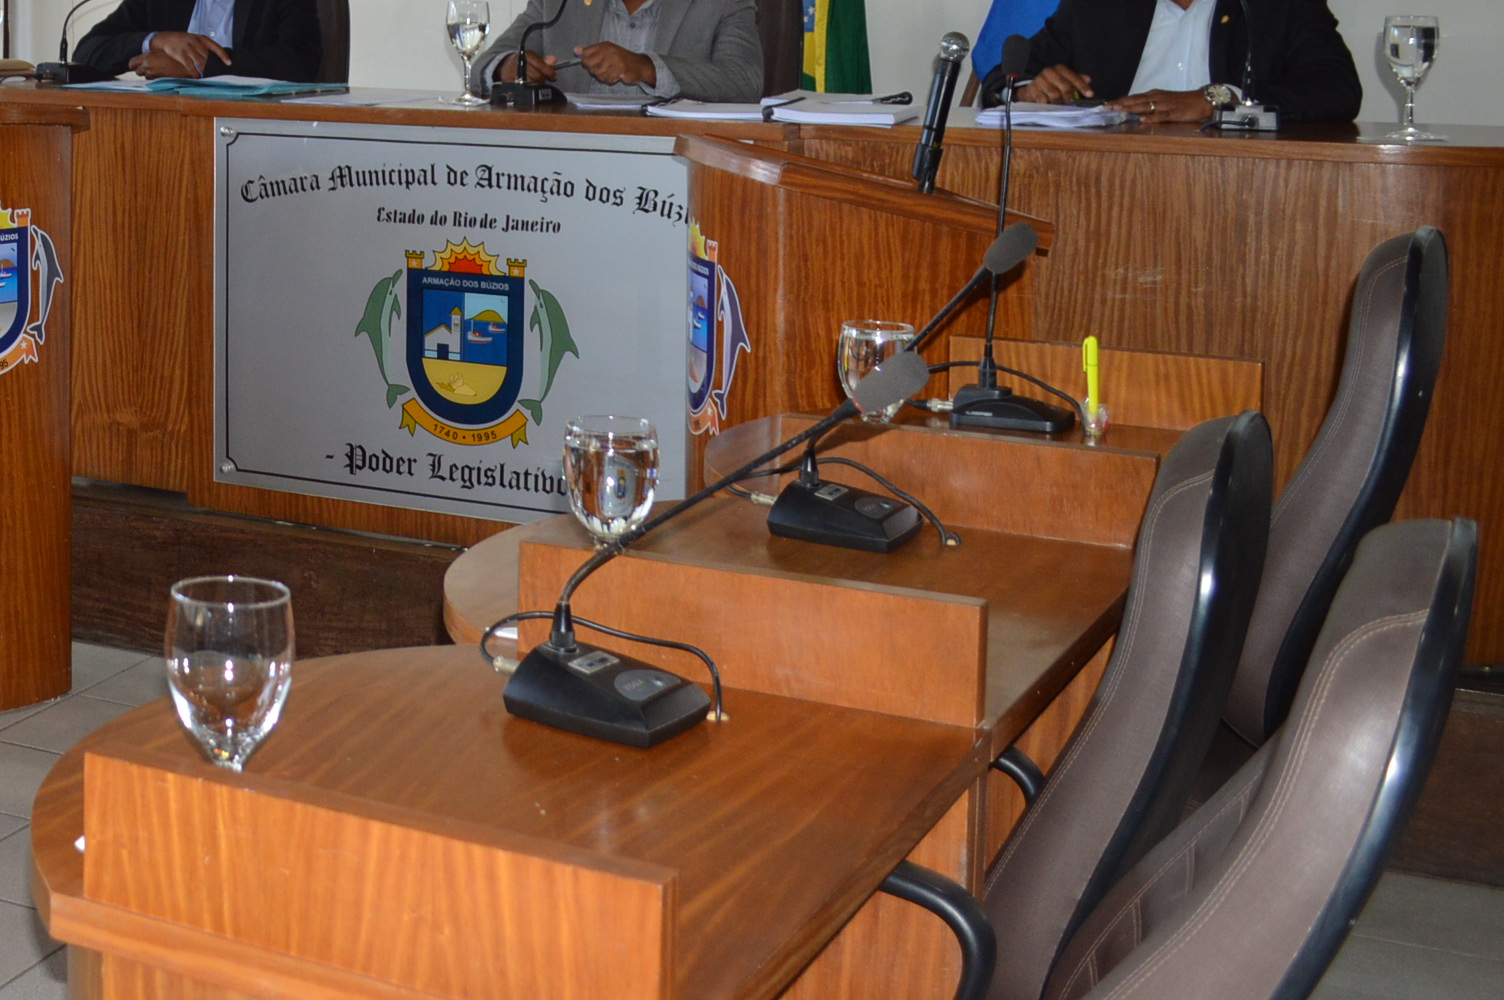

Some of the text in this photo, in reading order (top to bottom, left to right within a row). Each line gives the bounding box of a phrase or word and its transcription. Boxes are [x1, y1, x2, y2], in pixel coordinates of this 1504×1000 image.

[241, 174, 321, 203] Câmara
[328, 163, 438, 191] Municipal
[446, 164, 469, 187] de
[474, 164, 575, 203] Armação
[584, 177, 626, 207] dos
[376, 206, 425, 225] Estado
[429, 210, 448, 226] do
[501, 214, 562, 234] Janeiro
[422, 276, 510, 291] ARMAÇÃO DOS BÚZIOS
[433, 423, 497, 442] 1740 1995
[344, 442, 418, 477] Poder
